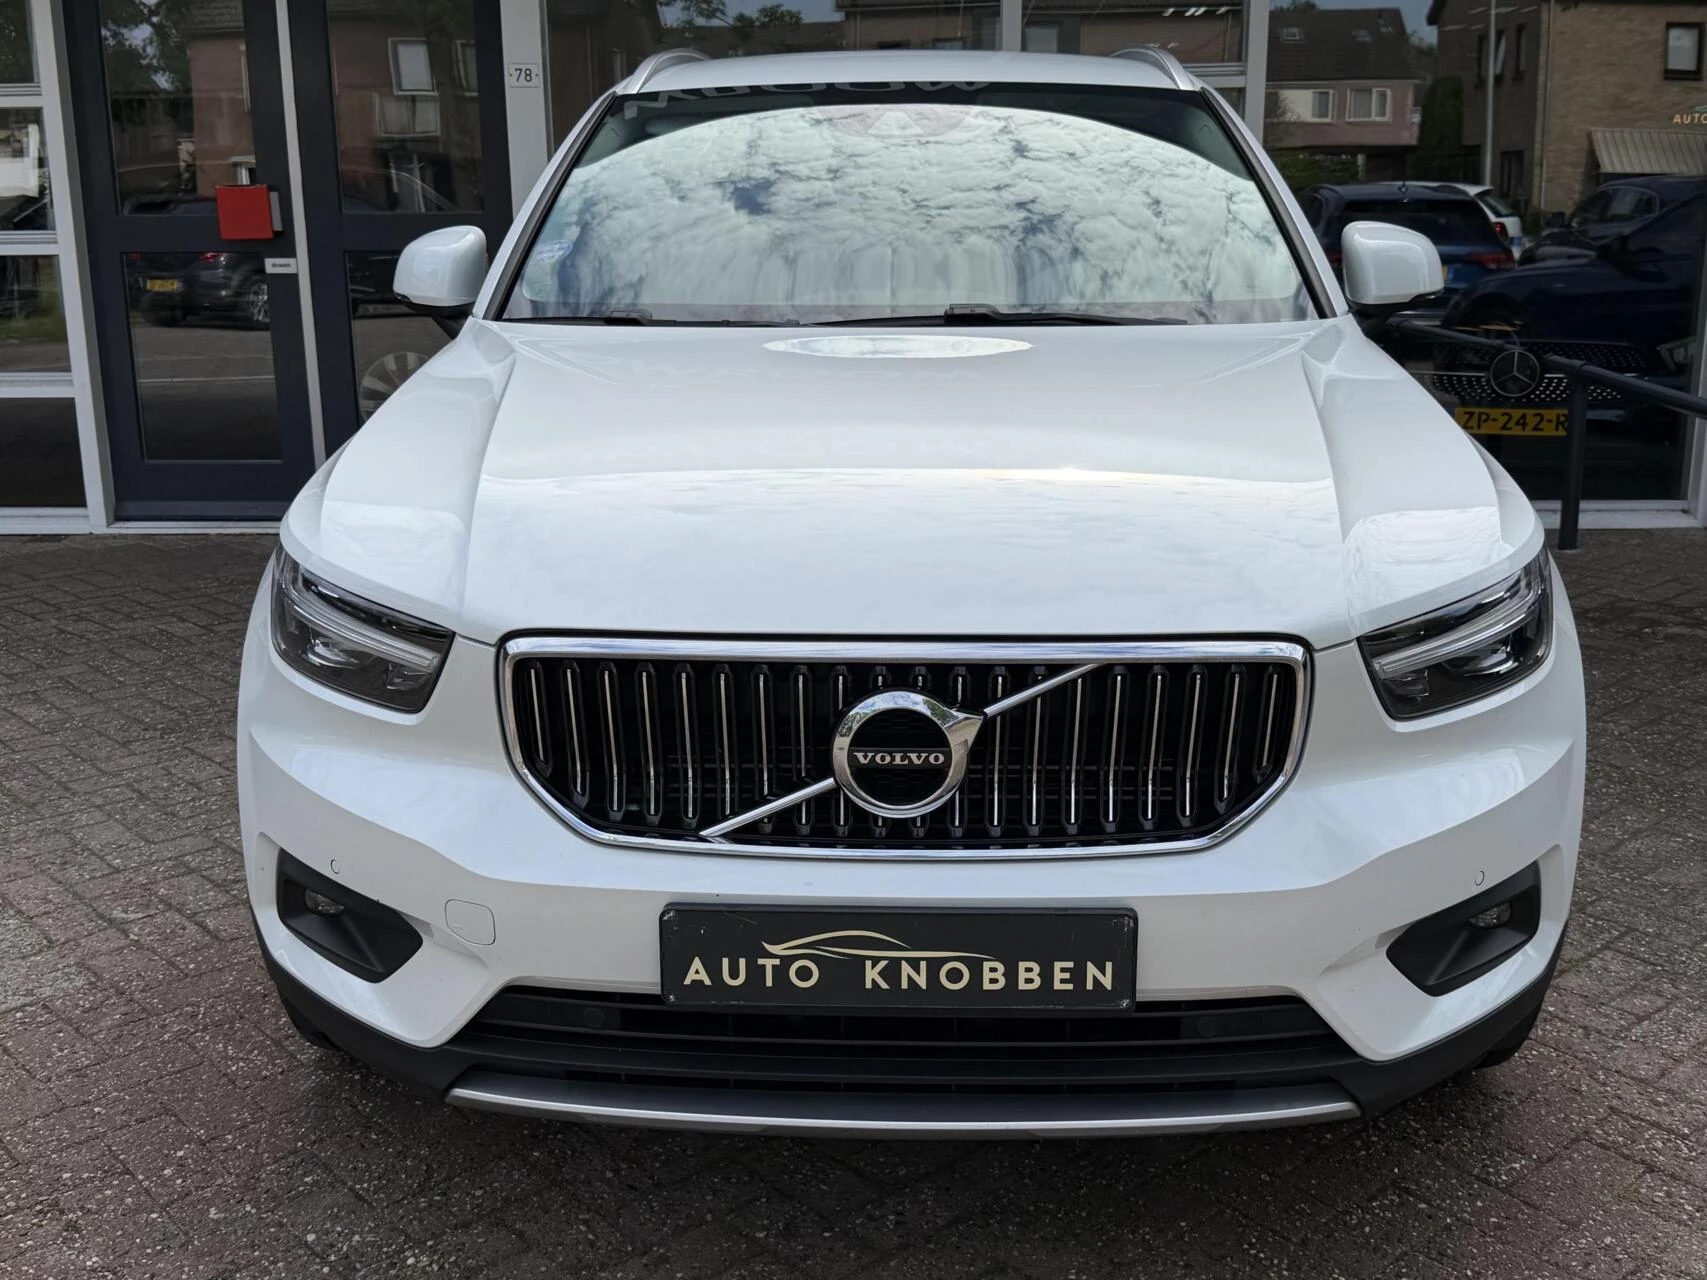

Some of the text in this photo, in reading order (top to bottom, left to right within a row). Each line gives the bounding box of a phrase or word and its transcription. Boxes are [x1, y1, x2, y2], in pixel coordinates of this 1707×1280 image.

[514, 68, 533, 82] 78
[853, 752, 945, 765] VOLVO
[683, 956, 1113, 991] AUTO KNOBBEN
